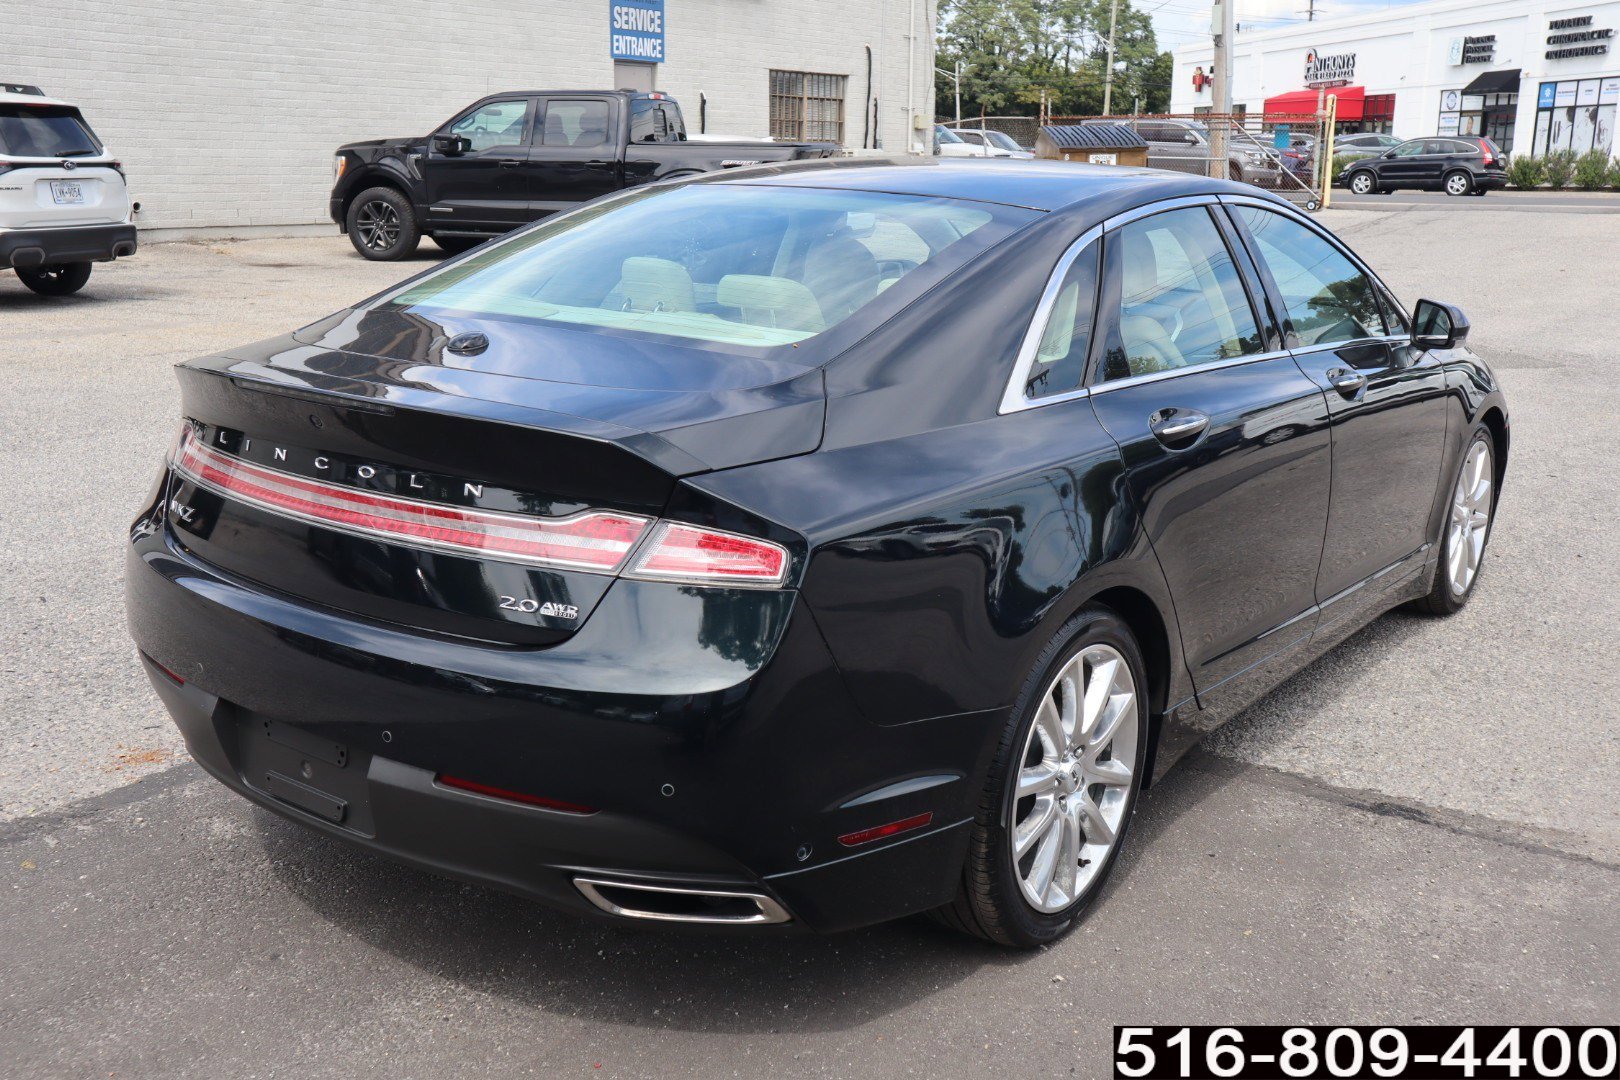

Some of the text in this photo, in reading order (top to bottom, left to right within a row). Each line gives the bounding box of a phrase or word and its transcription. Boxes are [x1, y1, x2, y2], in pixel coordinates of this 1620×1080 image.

[613, 5, 662, 33] SERVICE
[612, 34, 662, 58] ENTRANCE
[219, 431, 484, 498] LINCOLN
[499, 595, 539, 612] 2.0
